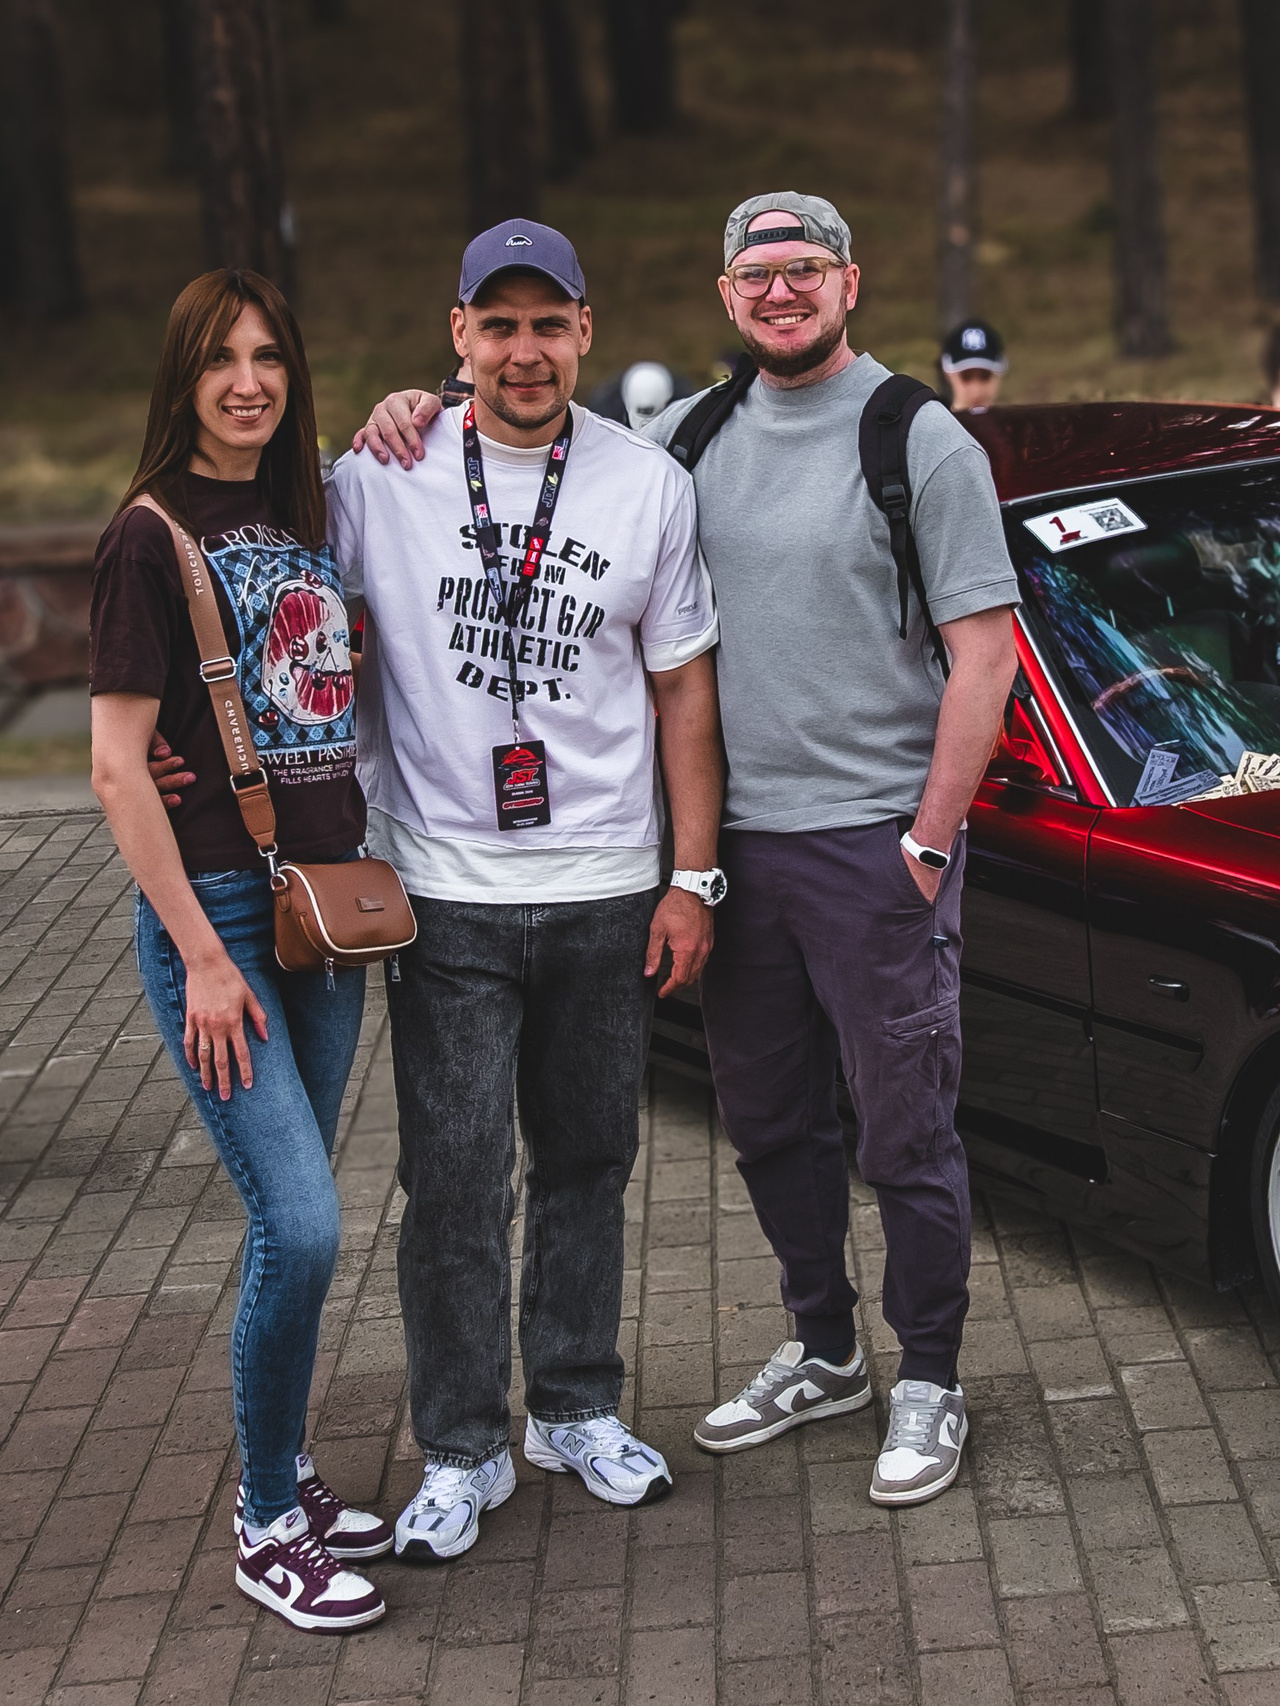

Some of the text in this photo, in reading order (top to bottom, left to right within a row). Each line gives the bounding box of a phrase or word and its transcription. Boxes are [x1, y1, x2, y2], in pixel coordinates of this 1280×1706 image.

[173, 520, 205, 595] TOUCHBRA
[448, 622, 581, 673] ATHLETIC
[258, 749, 312, 766] SWEET
[303, 773, 331, 783] HEARTS
[507, 769, 538, 786] JST
